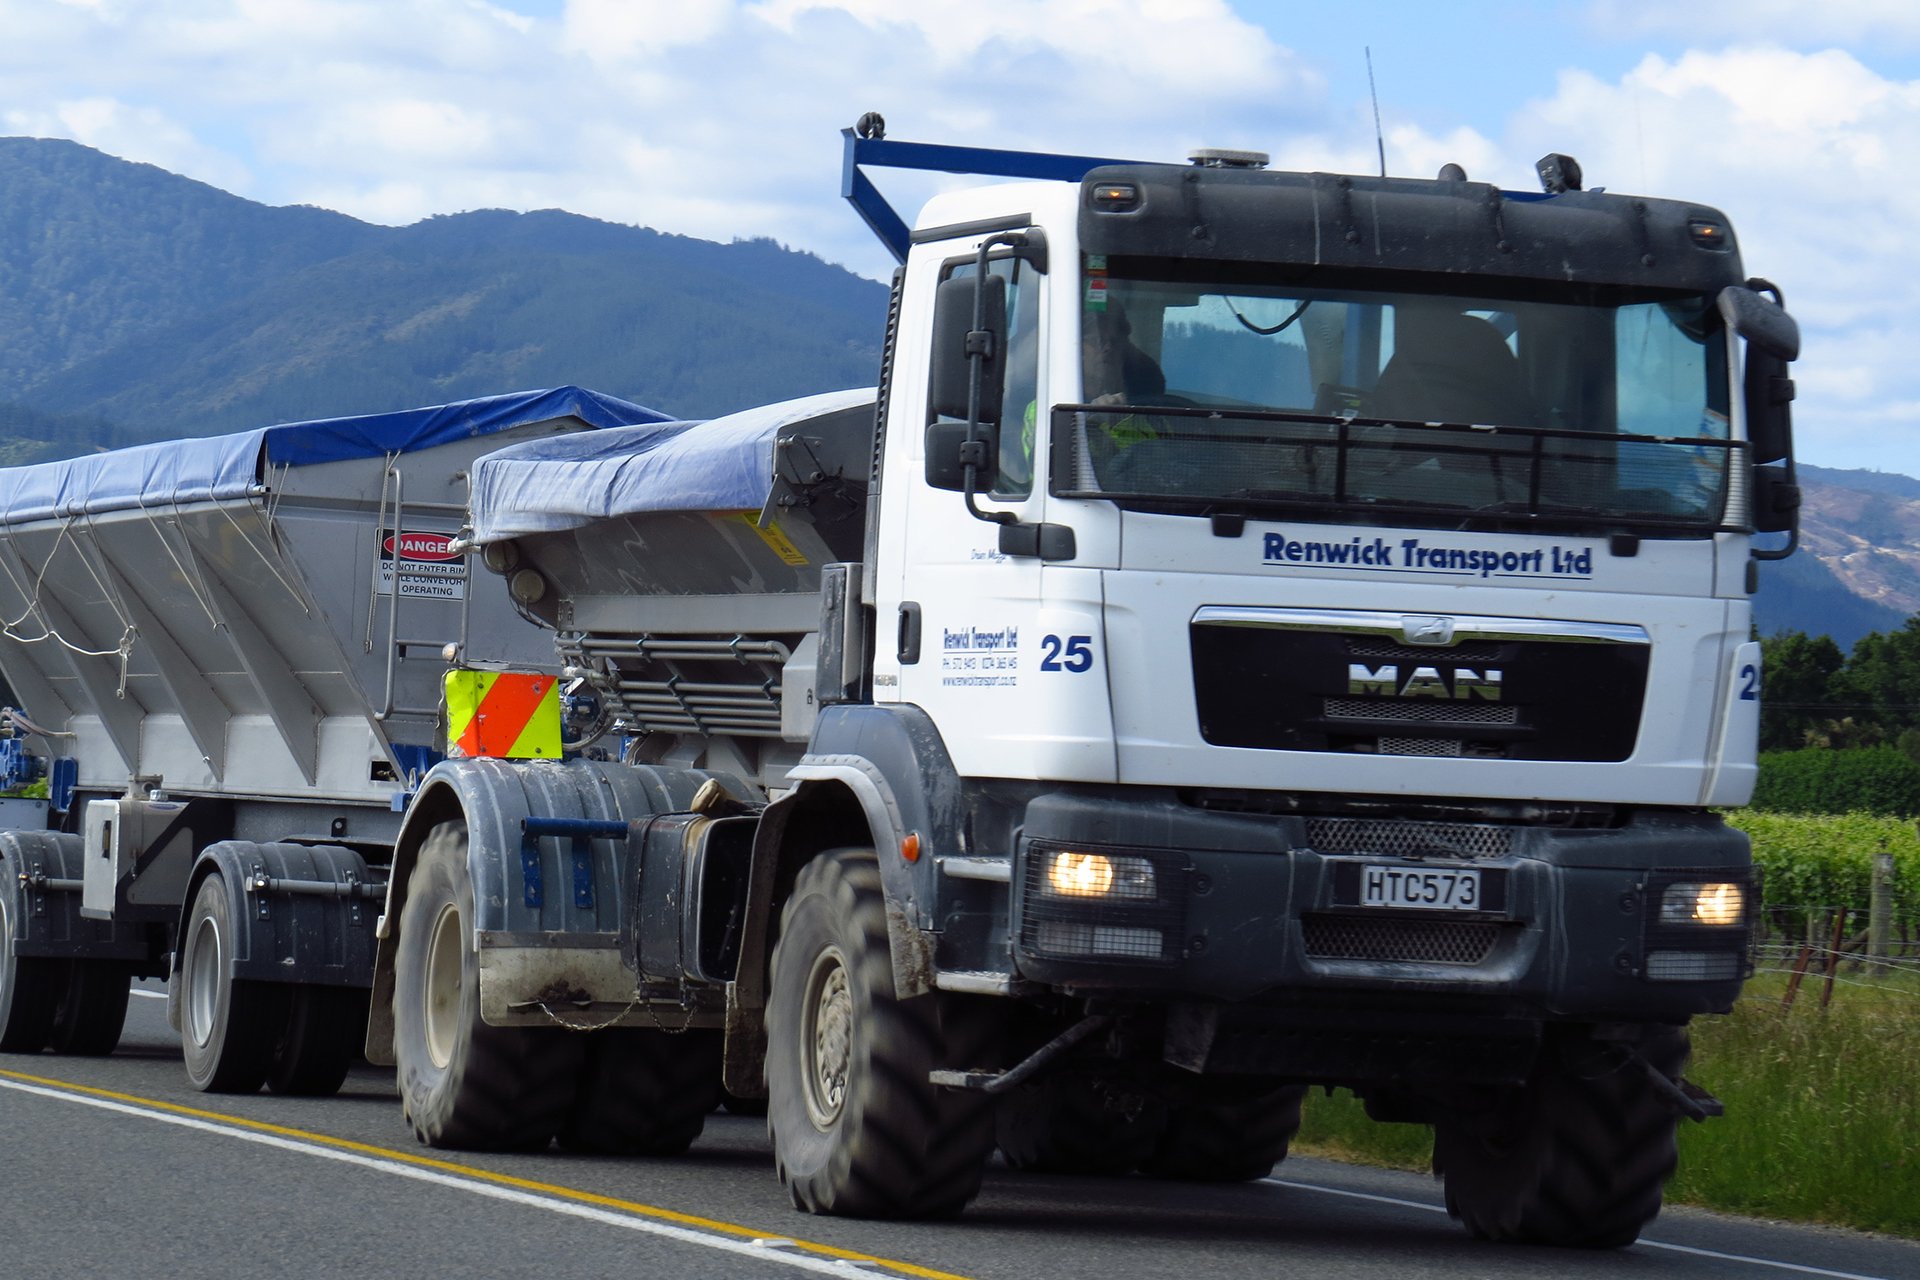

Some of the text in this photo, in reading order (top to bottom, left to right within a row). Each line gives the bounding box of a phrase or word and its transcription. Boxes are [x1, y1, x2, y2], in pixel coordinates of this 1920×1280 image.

[400, 540, 449, 553] ANGE
[1263, 532, 1593, 578] Renwick Transport Ltd
[383, 573, 463, 585] WLE CONVEYOR
[418, 565, 447, 573] ENTER
[401, 584, 453, 596] OPERATING
[1040, 634, 1093, 673] 25
[1348, 663, 1502, 700] MAN
[1367, 871, 1475, 905] HTC573
